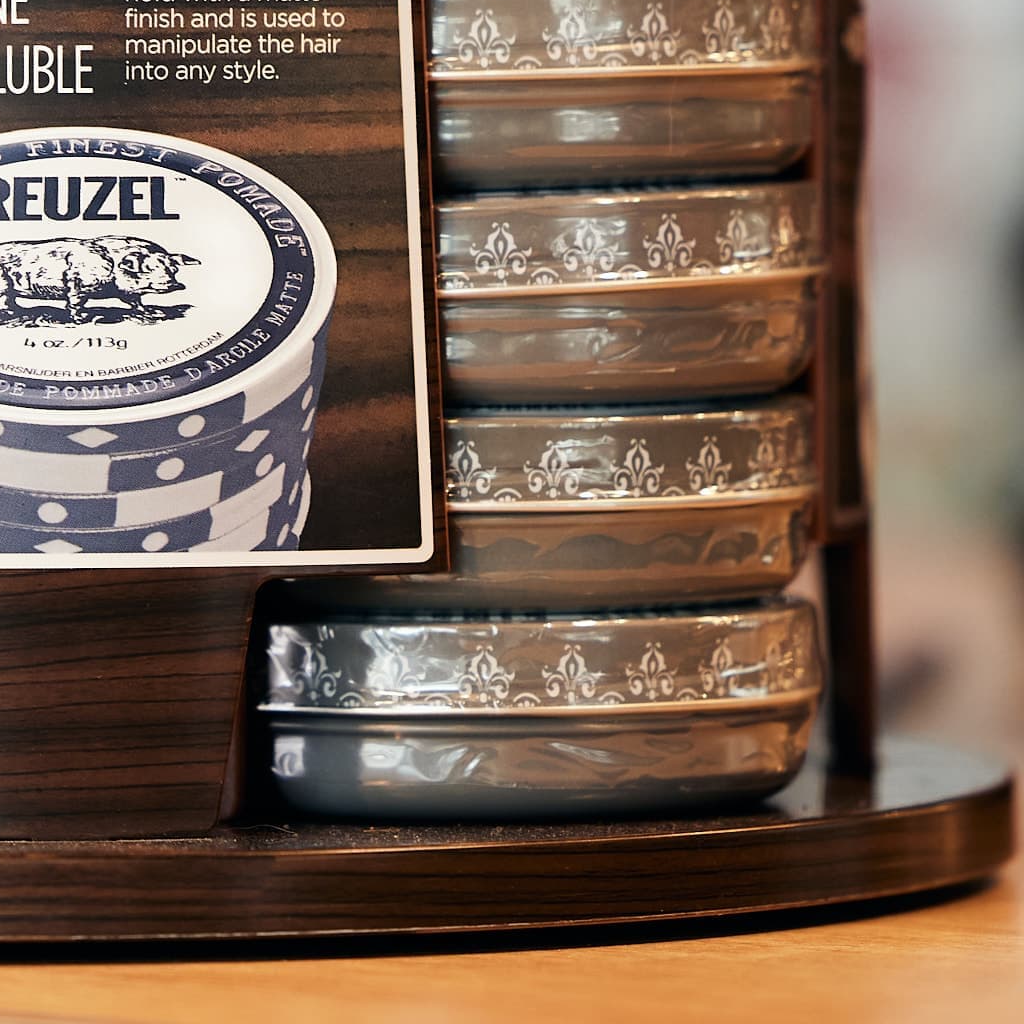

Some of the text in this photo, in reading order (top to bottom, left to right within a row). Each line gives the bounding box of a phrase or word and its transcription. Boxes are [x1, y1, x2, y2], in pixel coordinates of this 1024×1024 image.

[124, 7, 345, 28] finish and is used to
[125, 33, 342, 58] manipulate the hair
[125, 60, 280, 84] into any style.
[23, 137, 178, 164] FINEST
[23, 337, 36, 348] 4
[42, 374, 177, 401] POMMADE
[265, 271, 305, 328] MATTE
[97, 361, 155, 377] BARBIER
[156, 331, 225, 366] ROTTERDAM
